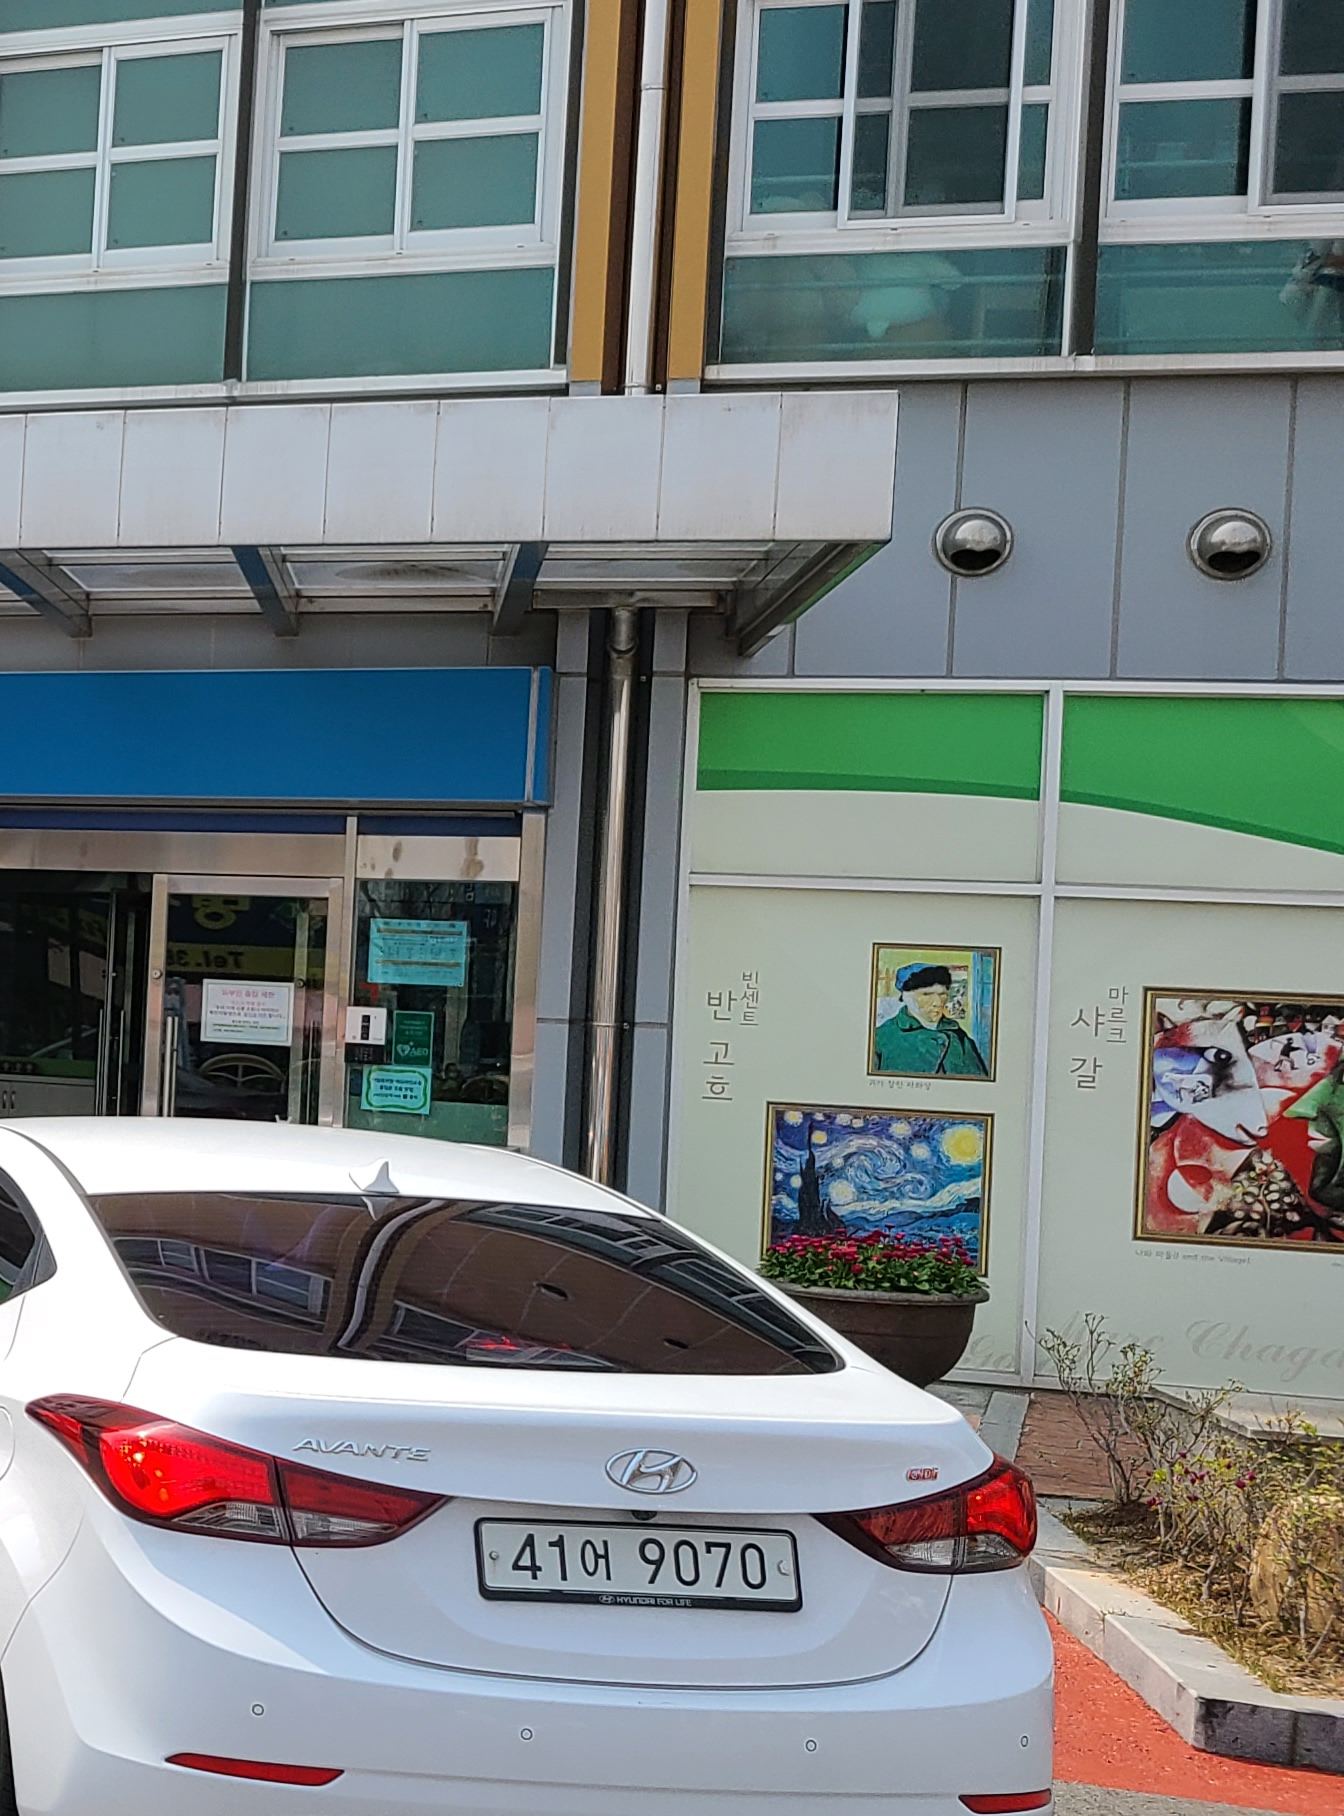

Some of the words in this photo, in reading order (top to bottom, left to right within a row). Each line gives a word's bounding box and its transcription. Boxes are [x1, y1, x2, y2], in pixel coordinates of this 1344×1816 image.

[739, 970, 759, 1026] 빈센트
[1106, 985, 1129, 1043] 마르크
[1070, 1006, 1106, 1089] 샤갈
[292, 1438, 431, 1462] AVANTE
[512, 1533, 612, 1581] 41어
[638, 1538, 767, 1590] 9070
[616, 1596, 656, 1605] HYUNDAI
[675, 1599, 692, 1607] LIFE
